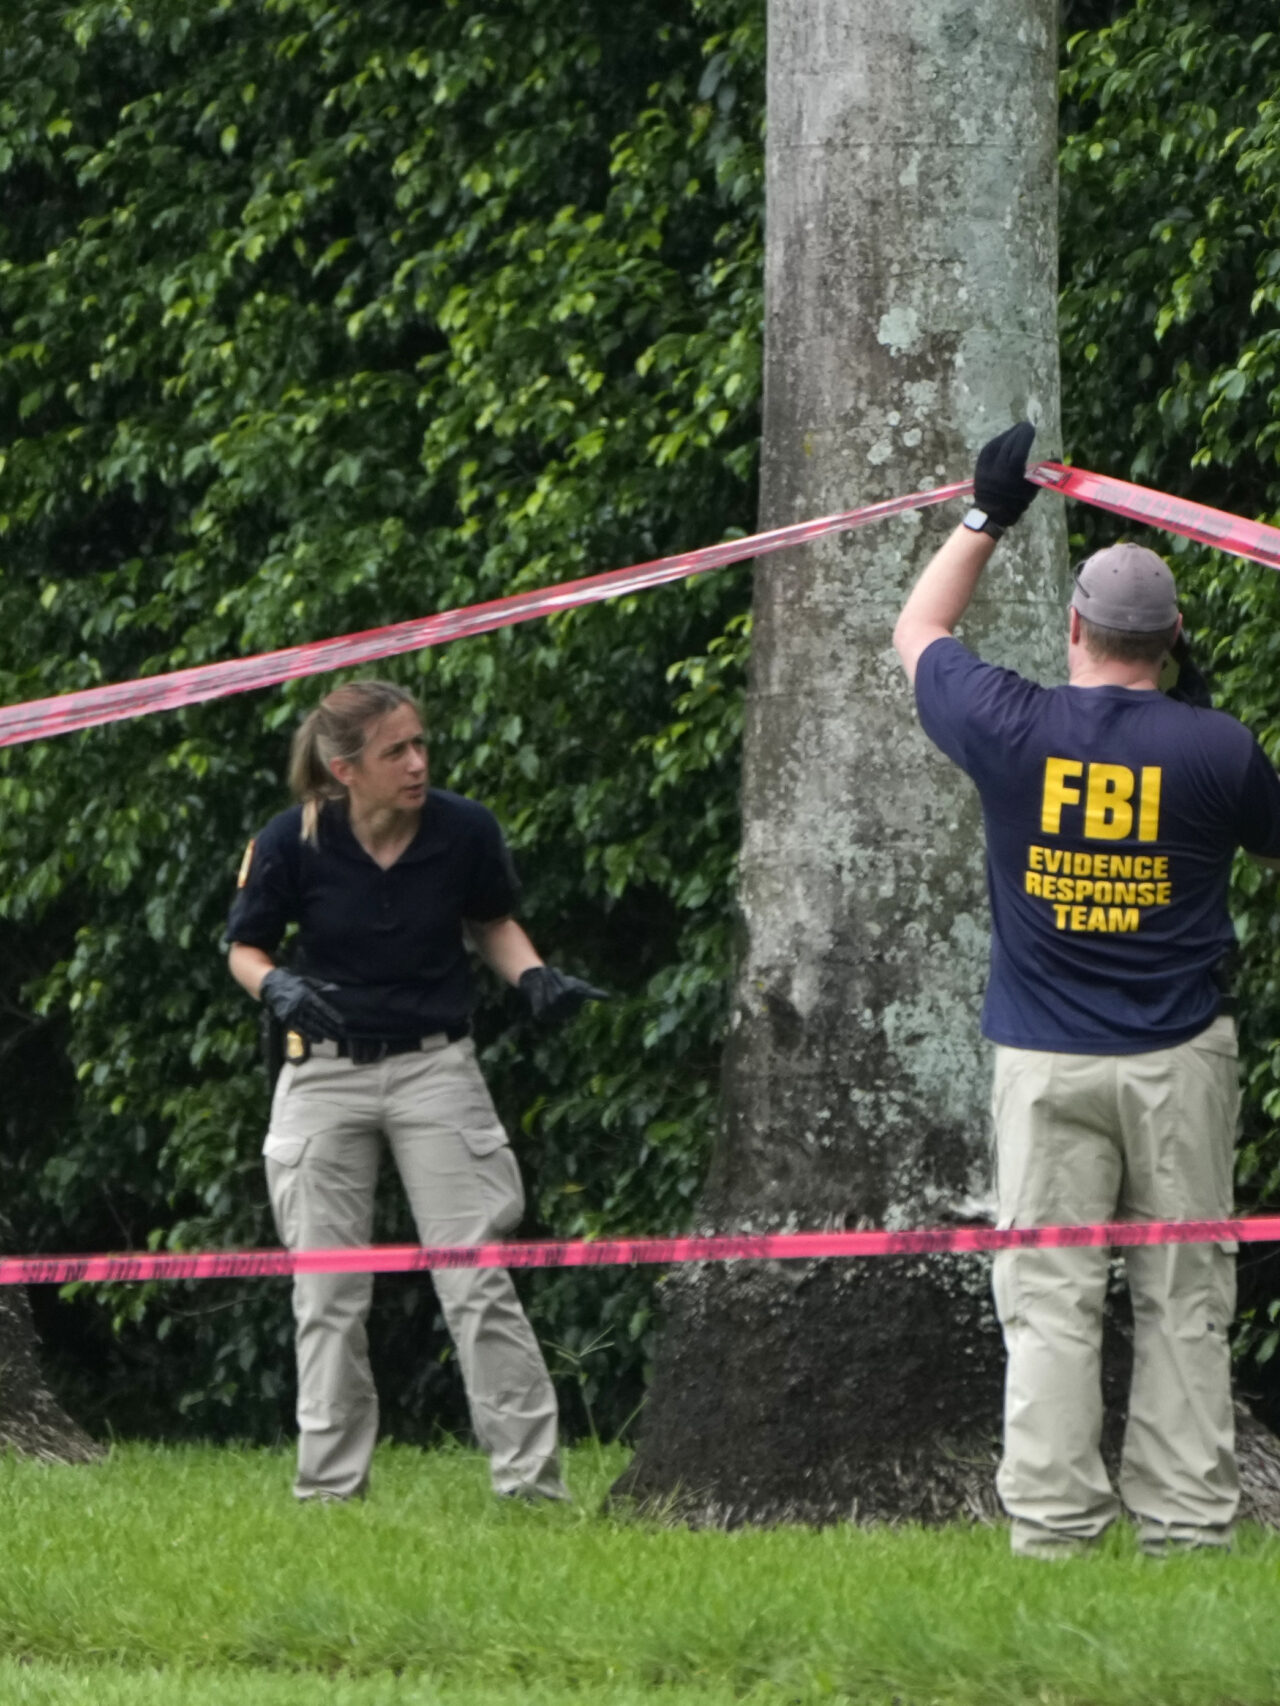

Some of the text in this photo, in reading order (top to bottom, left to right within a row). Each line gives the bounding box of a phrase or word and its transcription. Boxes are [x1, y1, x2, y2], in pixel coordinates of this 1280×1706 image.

[1041, 757, 1162, 842] FBI
[1028, 845, 1169, 880] EVIDENCE
[1024, 870, 1172, 905] RESPONSE
[1052, 903, 1140, 933] TEAM
